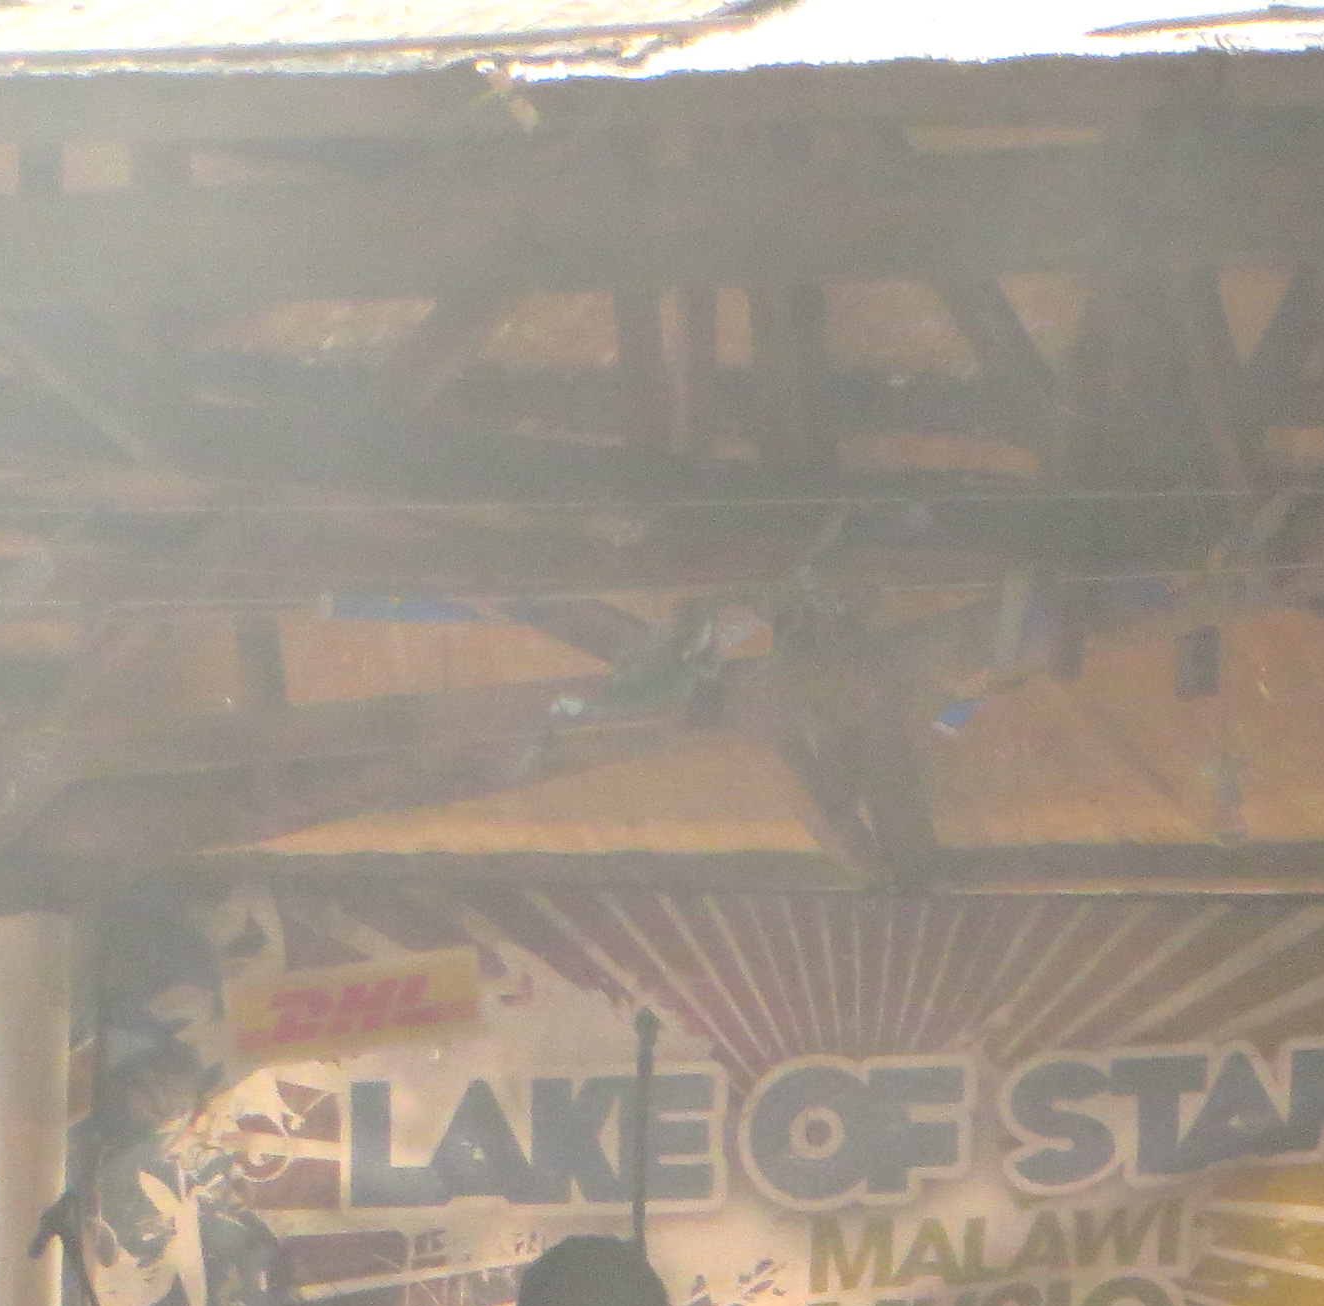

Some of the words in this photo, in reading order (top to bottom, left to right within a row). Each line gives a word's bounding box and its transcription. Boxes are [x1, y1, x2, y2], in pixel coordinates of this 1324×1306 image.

[348, 1072, 716, 1204] LAKE
[747, 1062, 965, 1200] OF
[809, 1201, 1181, 1294] MALAWI
